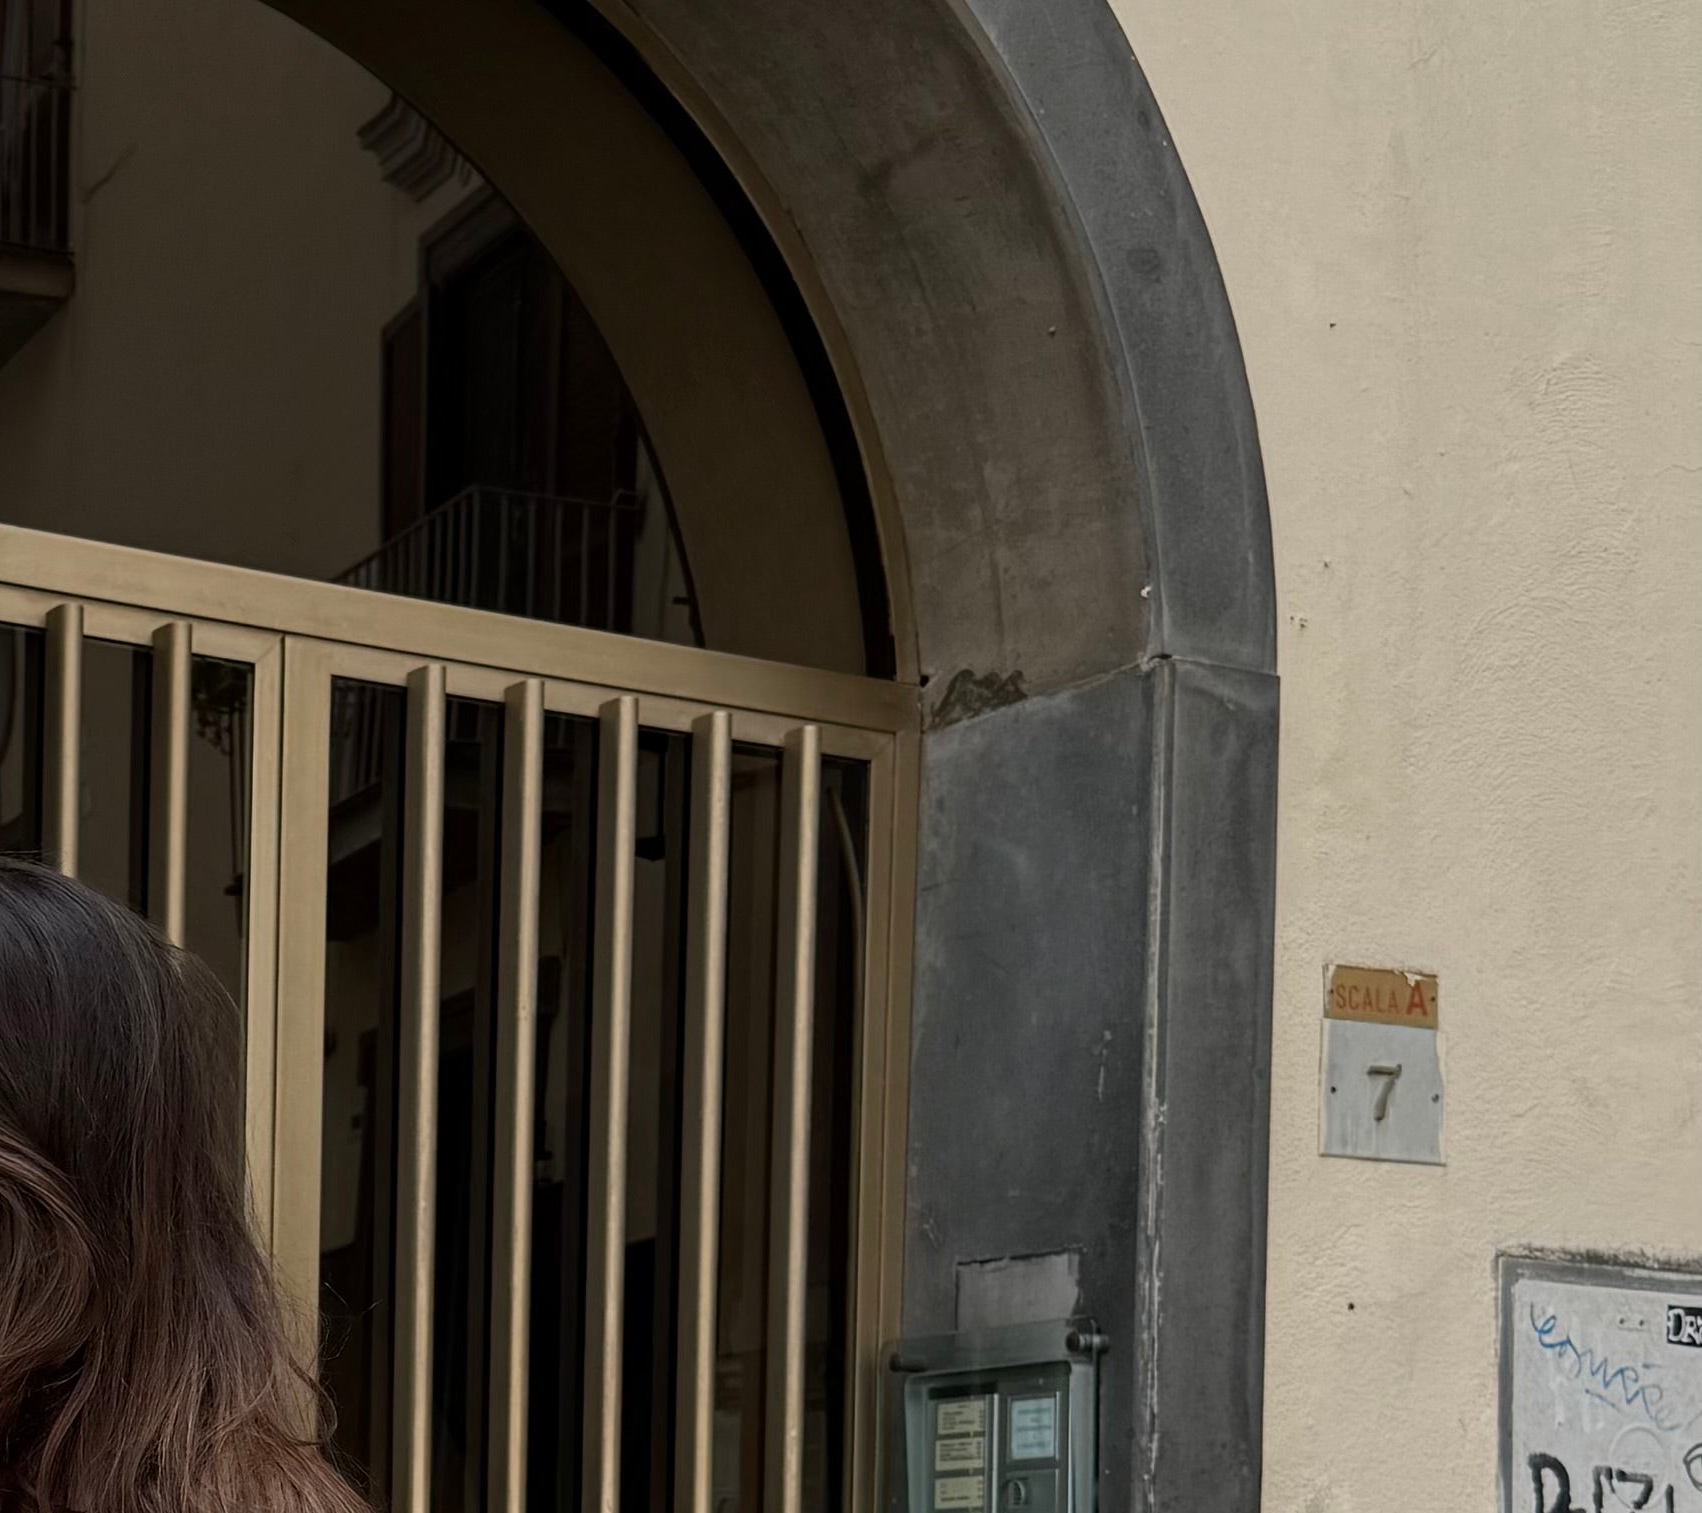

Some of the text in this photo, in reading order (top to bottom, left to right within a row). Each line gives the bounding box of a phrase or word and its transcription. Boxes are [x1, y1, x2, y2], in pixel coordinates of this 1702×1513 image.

[1335, 980, 1429, 1017] SCALA A
[1367, 1063, 1402, 1122] 7
